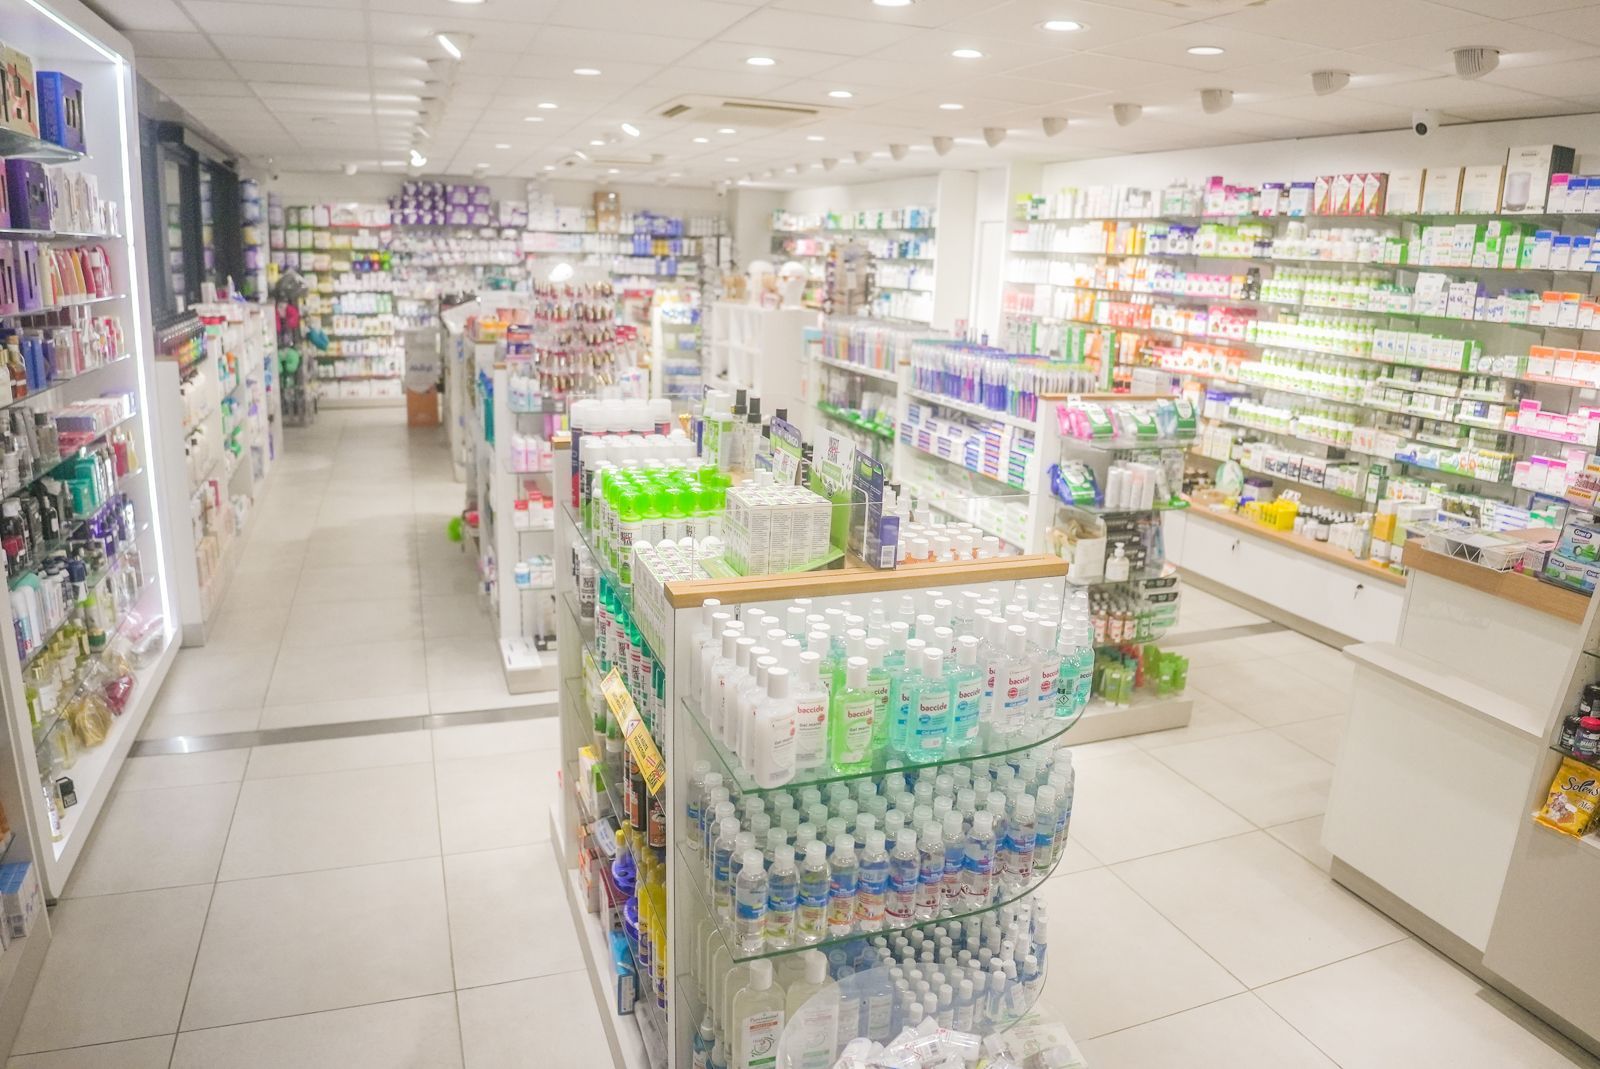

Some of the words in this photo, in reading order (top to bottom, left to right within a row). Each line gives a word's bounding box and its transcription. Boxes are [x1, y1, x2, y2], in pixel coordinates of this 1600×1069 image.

[874, 687, 888, 695] cide
[959, 688, 980, 699] baccide
[797, 705, 824, 714] baccide
[920, 703, 947, 712] baccide
[847, 708, 873, 718] baccide
